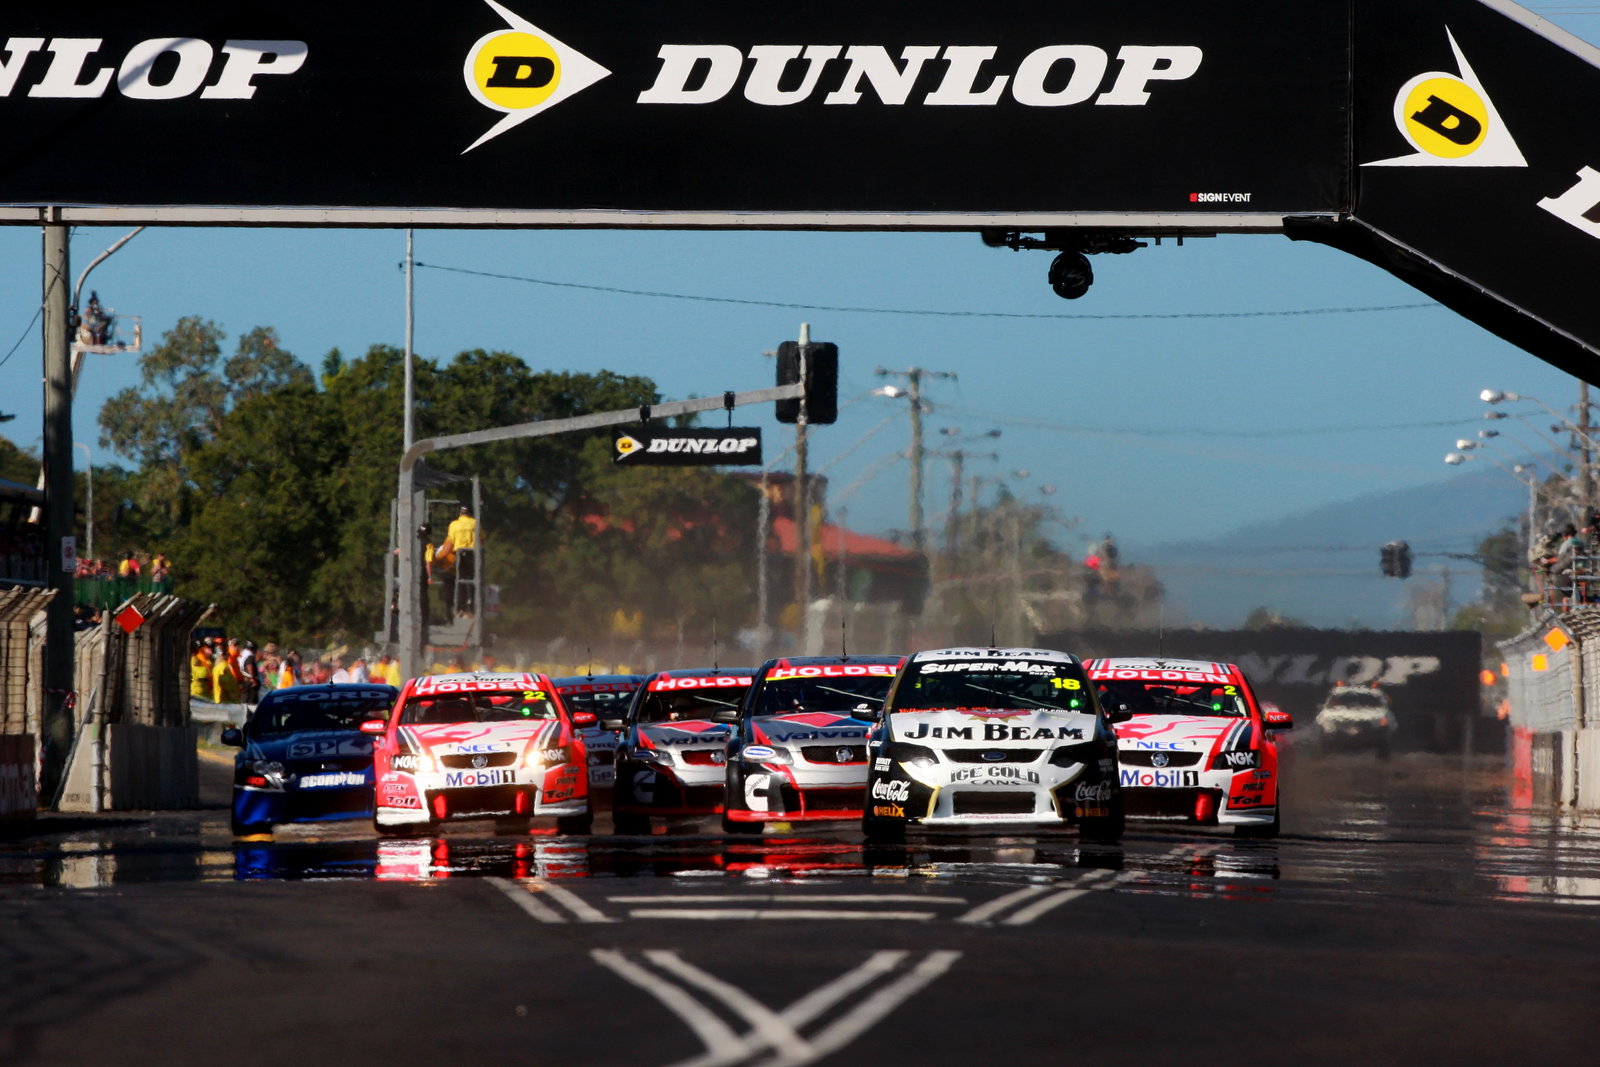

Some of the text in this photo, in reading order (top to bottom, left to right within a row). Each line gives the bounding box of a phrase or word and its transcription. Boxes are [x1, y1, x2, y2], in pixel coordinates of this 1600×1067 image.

[637, 44, 1203, 107] DUNLOP
[646, 438, 757, 454] DUNLOP
[920, 661, 1057, 674] SUPER-MAX
[1092, 670, 1229, 683] HOLDEN
[416, 681, 539, 695] HOLDEN
[1050, 678, 1081, 690] 18
[1223, 685, 1237, 696] 2
[273, 690, 390, 703] FORD
[523, 690, 546, 701] 22
[904, 723, 1085, 741] JIM BEAM
[457, 744, 500, 753] NEC
[1137, 741, 1184, 751] NEC
[1225, 751, 1255, 766] NGK
[446, 769, 500, 786] Mobil
[951, 766, 1040, 784] ICE COLD
[1120, 770, 1180, 786] Mobil
[1230, 794, 1263, 805] Toll
[878, 802, 905, 817] HELIX
